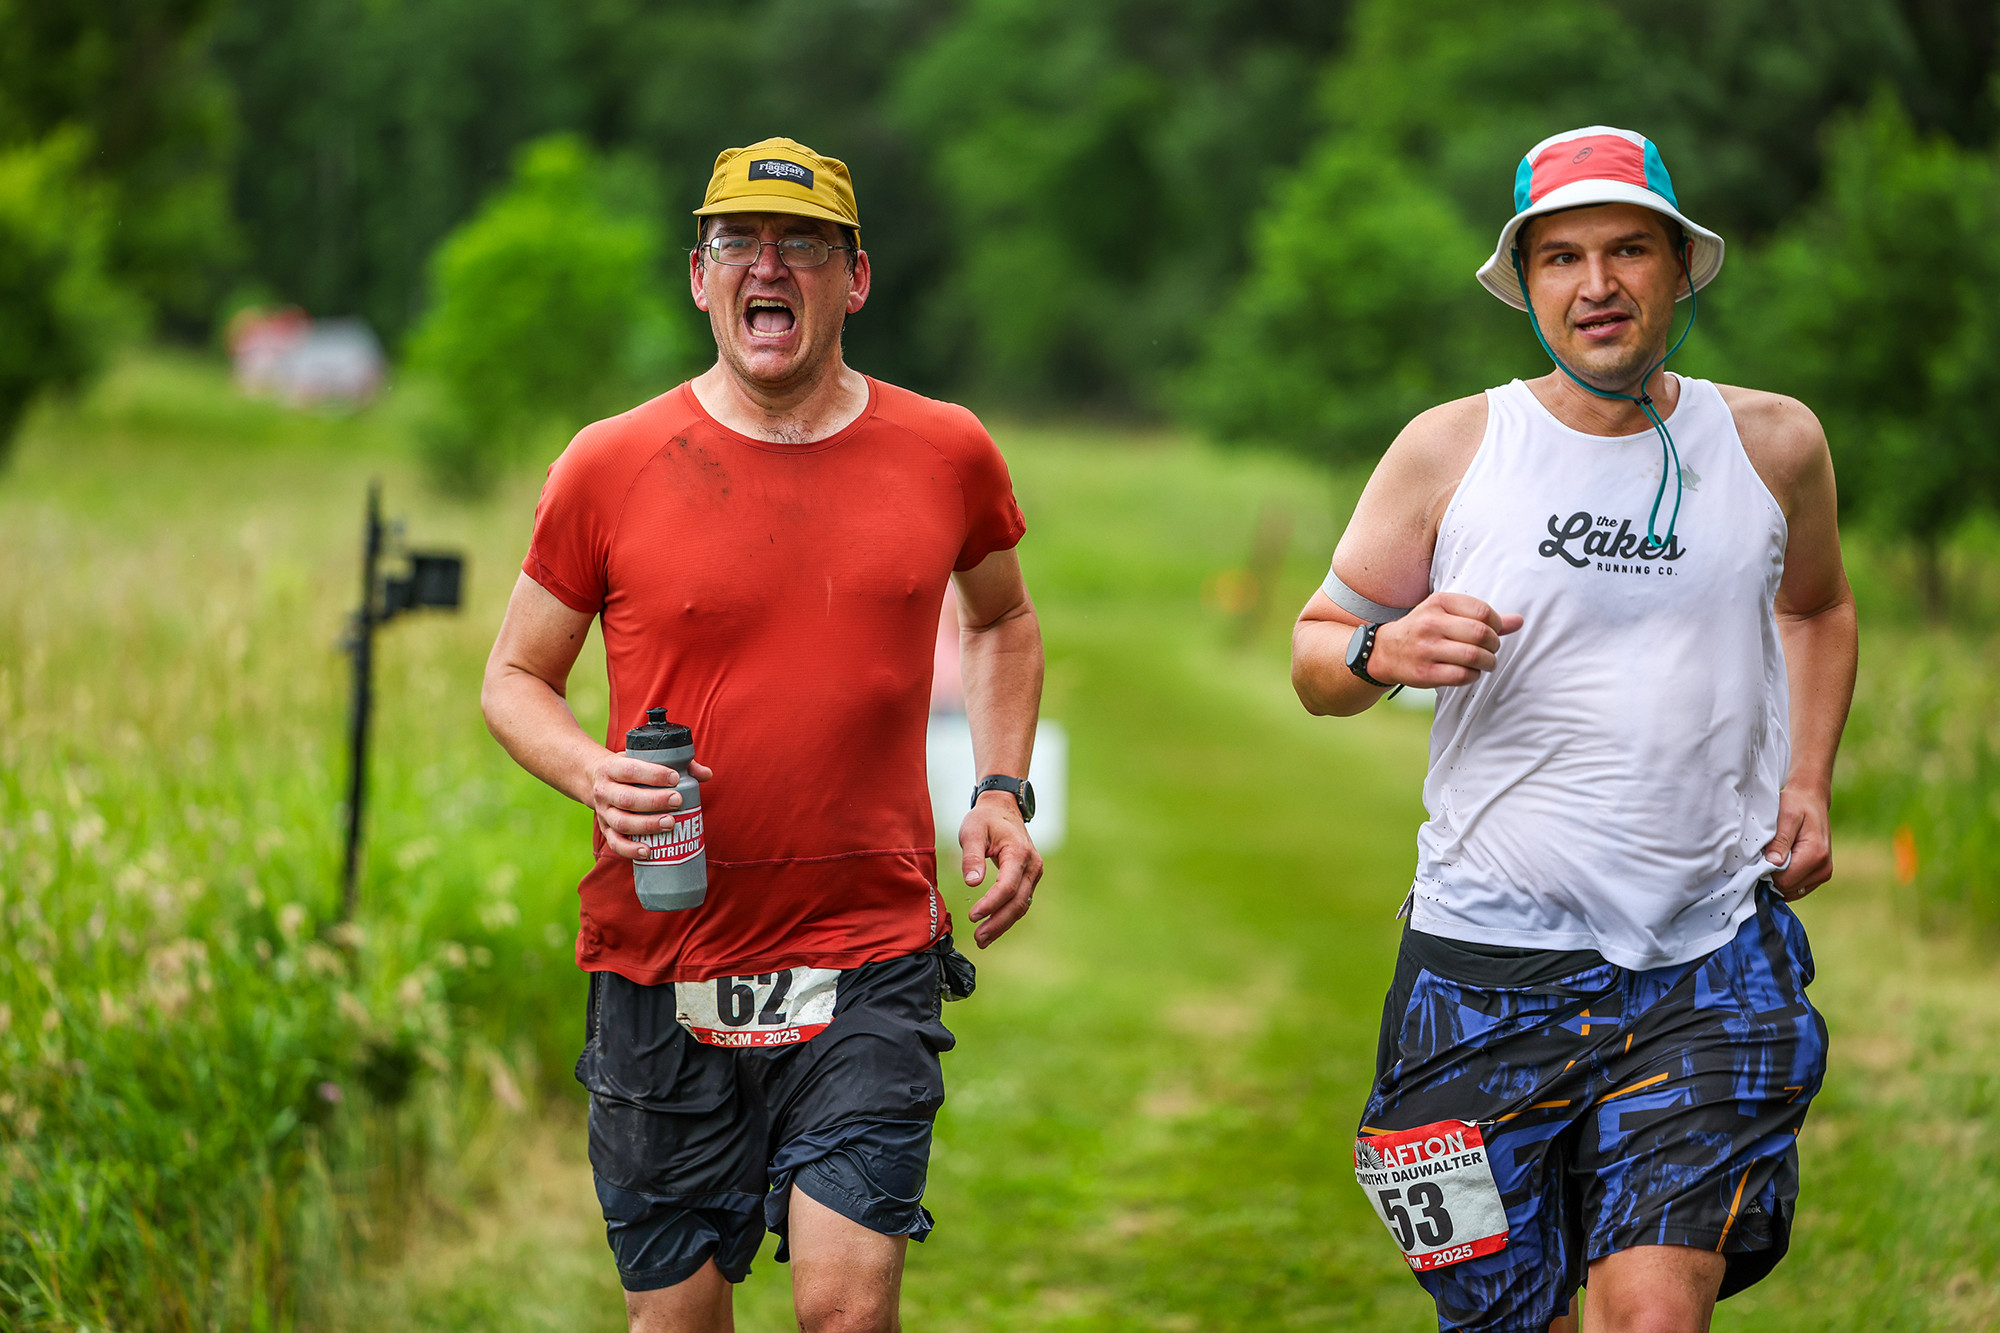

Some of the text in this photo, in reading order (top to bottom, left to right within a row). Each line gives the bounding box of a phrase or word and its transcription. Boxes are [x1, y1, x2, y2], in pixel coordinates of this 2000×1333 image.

[1596, 516, 1618, 528] the
[1538, 511, 1686, 568] Lakes
[1597, 562, 1678, 576] RUNNING CO.
[716, 968, 794, 1027] 62
[763, 1029, 801, 1045] 2025
[1383, 1130, 1466, 1168] AFTON
[1392, 1151, 1483, 1184] DAUWALTER
[1377, 1182, 1454, 1252] 53
[1432, 1244, 1474, 1266] 2025
